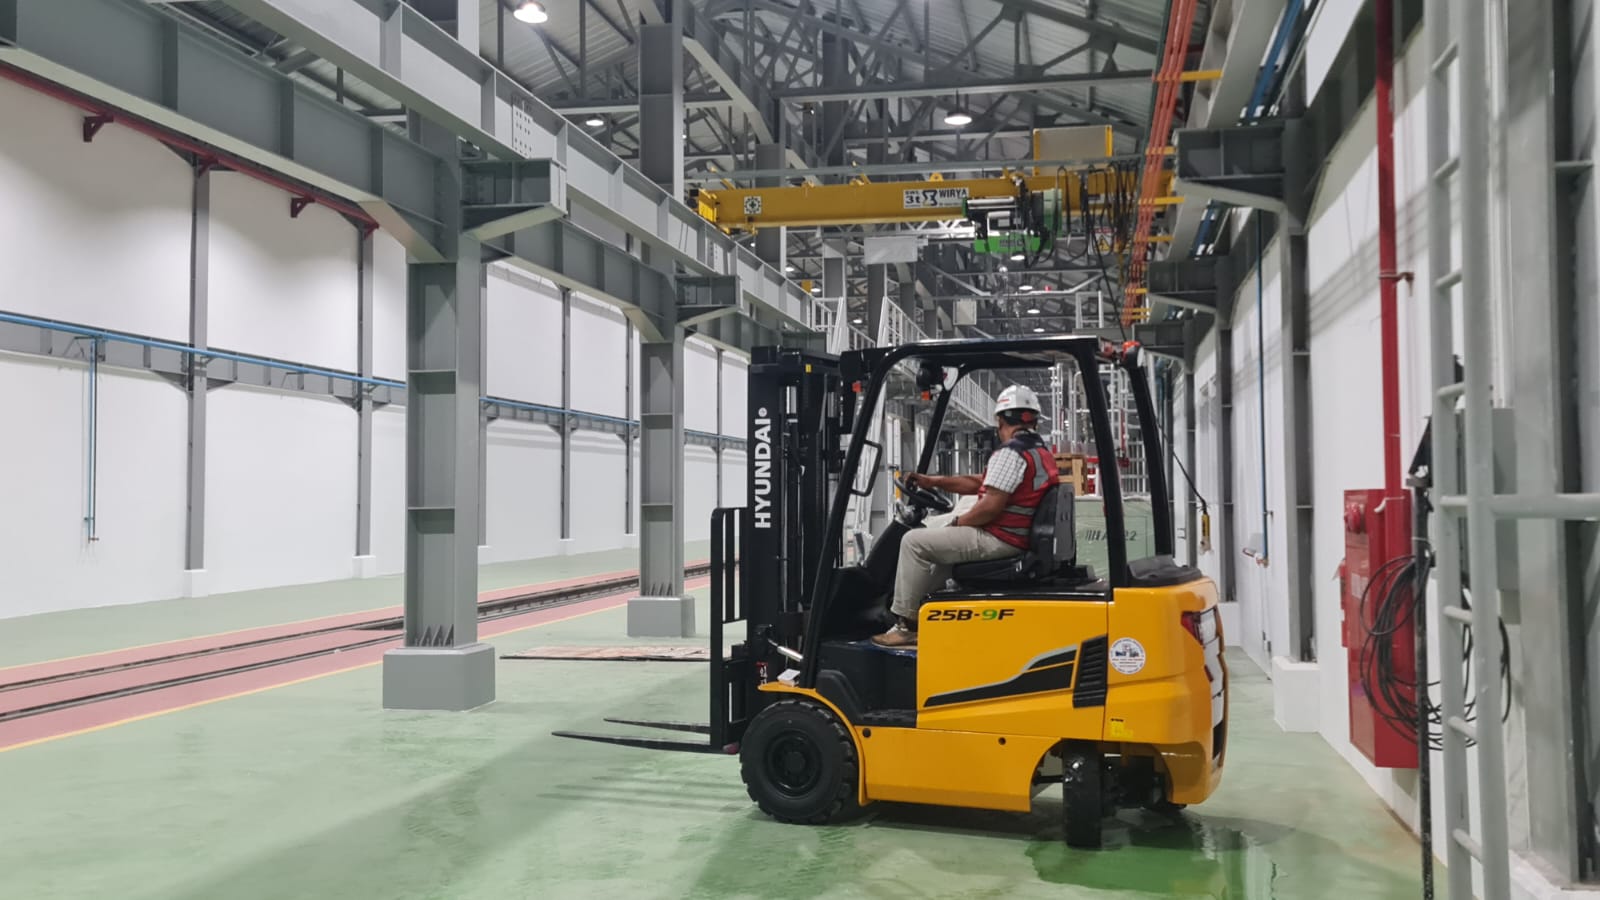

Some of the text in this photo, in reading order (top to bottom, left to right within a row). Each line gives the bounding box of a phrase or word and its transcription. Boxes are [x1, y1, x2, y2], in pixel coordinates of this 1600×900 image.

[939, 189, 967, 198] WIRYA
[754, 418, 772, 529] HYUNDAI
[926, 608, 1016, 622] 25B-9F
